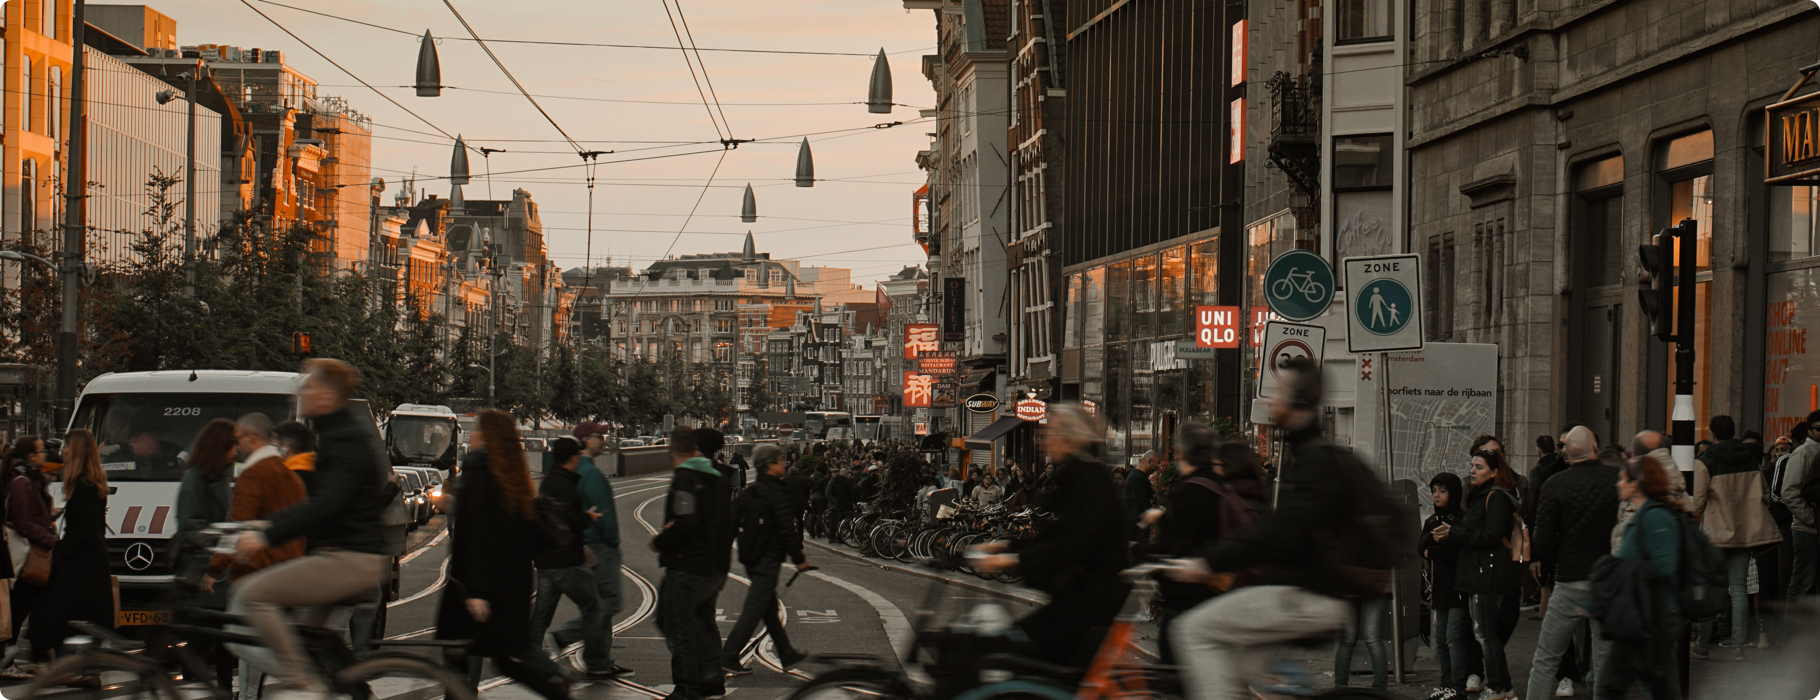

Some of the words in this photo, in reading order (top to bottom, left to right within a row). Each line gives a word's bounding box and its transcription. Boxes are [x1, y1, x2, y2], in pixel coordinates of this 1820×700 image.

[1782, 108, 1820, 164] MA
[1336, 210, 1378, 253] Coffee
[1364, 262, 1400, 273] ZONE
[950, 280, 959, 331] OUTLET
[1768, 301, 1795, 328] SHOP
[1201, 311, 1232, 326] UNI
[1201, 328, 1235, 345] QLO
[1282, 327, 1309, 337] ZONE
[1767, 328, 1806, 356] ONLINE
[1766, 359, 1788, 384] 24/7
[1447, 387, 1459, 396] de
[1461, 387, 1492, 399] rijbaan
[1765, 387, 1779, 413] EN
[163, 407, 201, 416] 2208
[1016, 412, 1045, 420] RESTAURANT
[1764, 416, 1808, 442] ONTD
